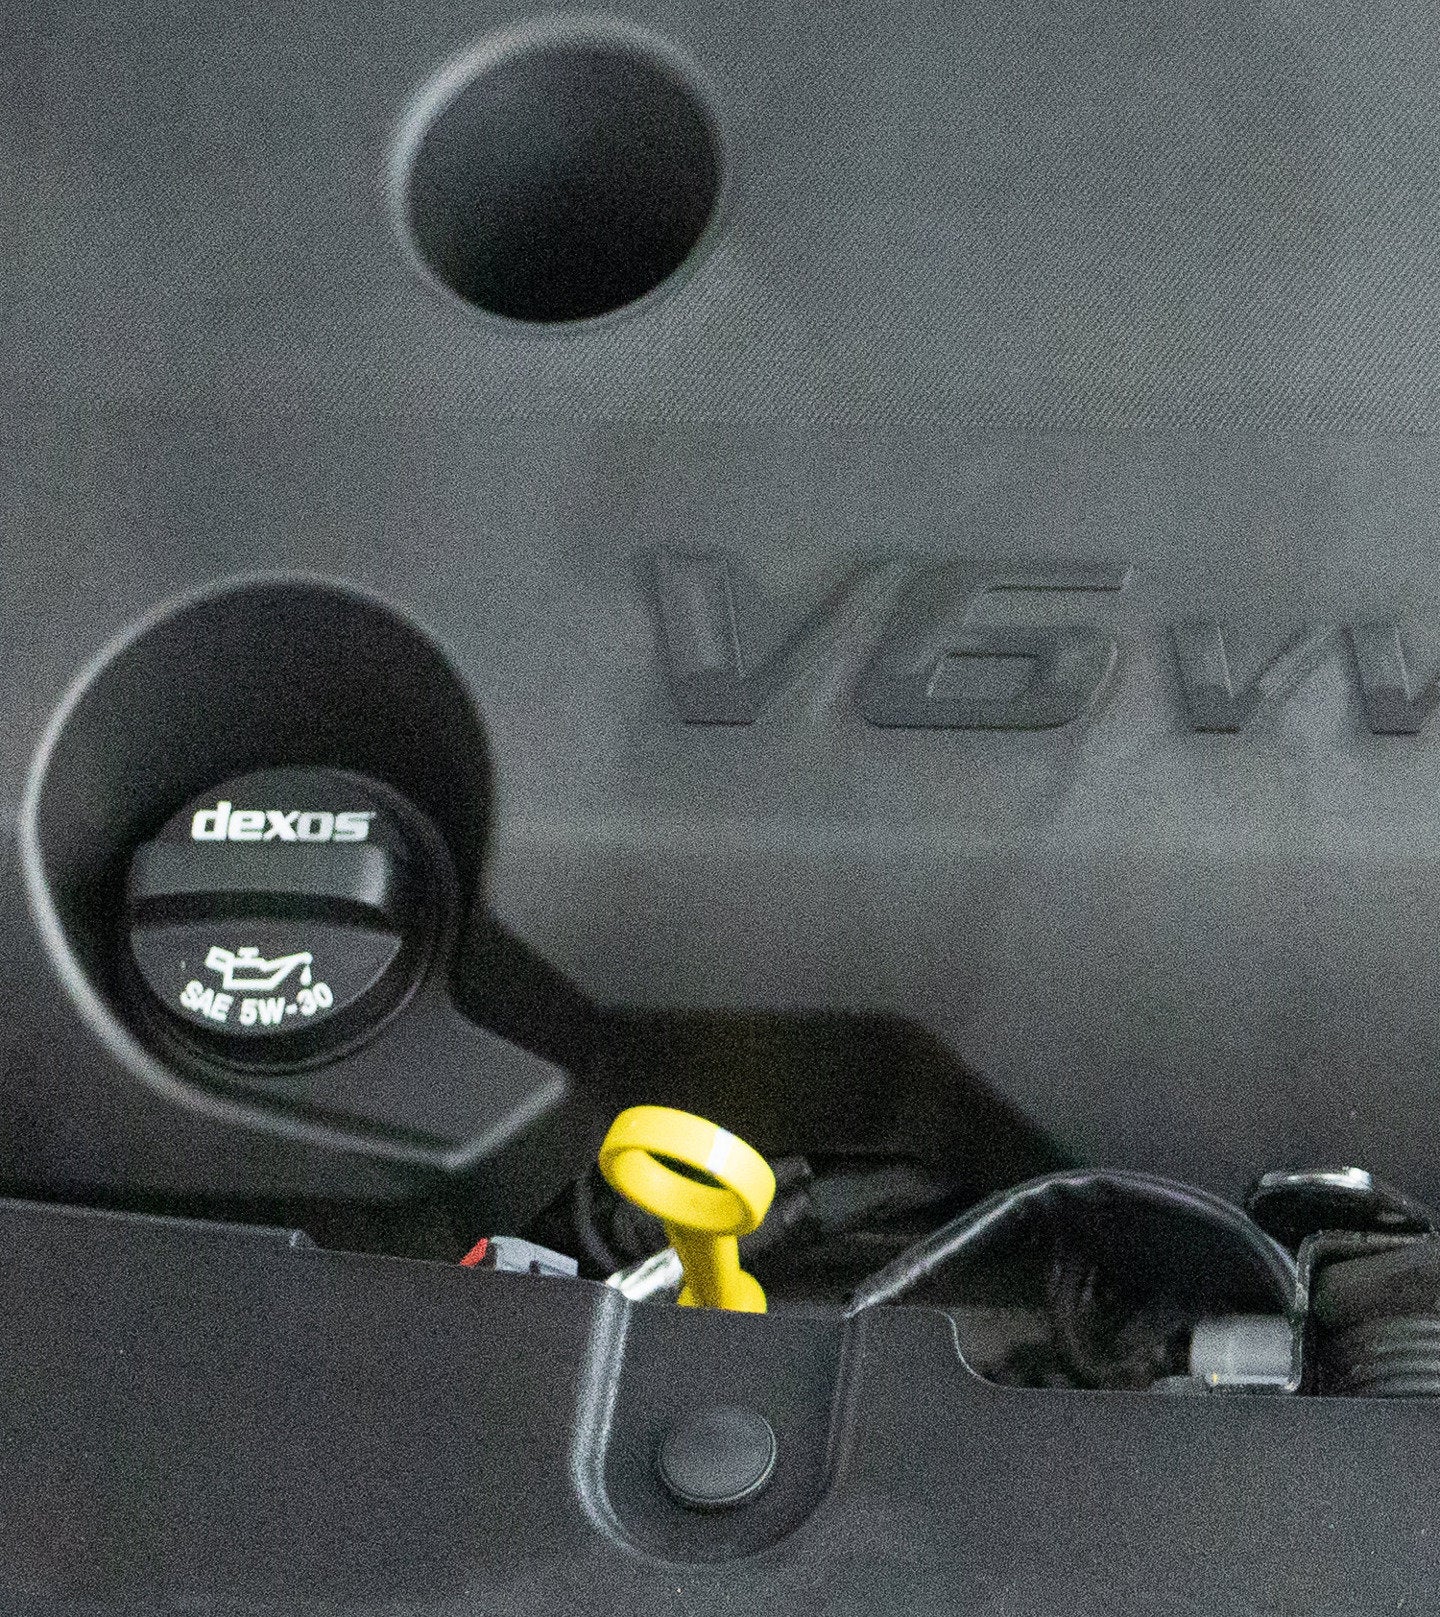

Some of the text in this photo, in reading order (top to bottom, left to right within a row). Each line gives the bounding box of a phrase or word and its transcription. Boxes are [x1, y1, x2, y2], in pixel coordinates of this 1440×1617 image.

[640, 545, 1135, 732] V6
[191, 800, 373, 841] dexos
[180, 979, 334, 1026] SAE 5W-30
